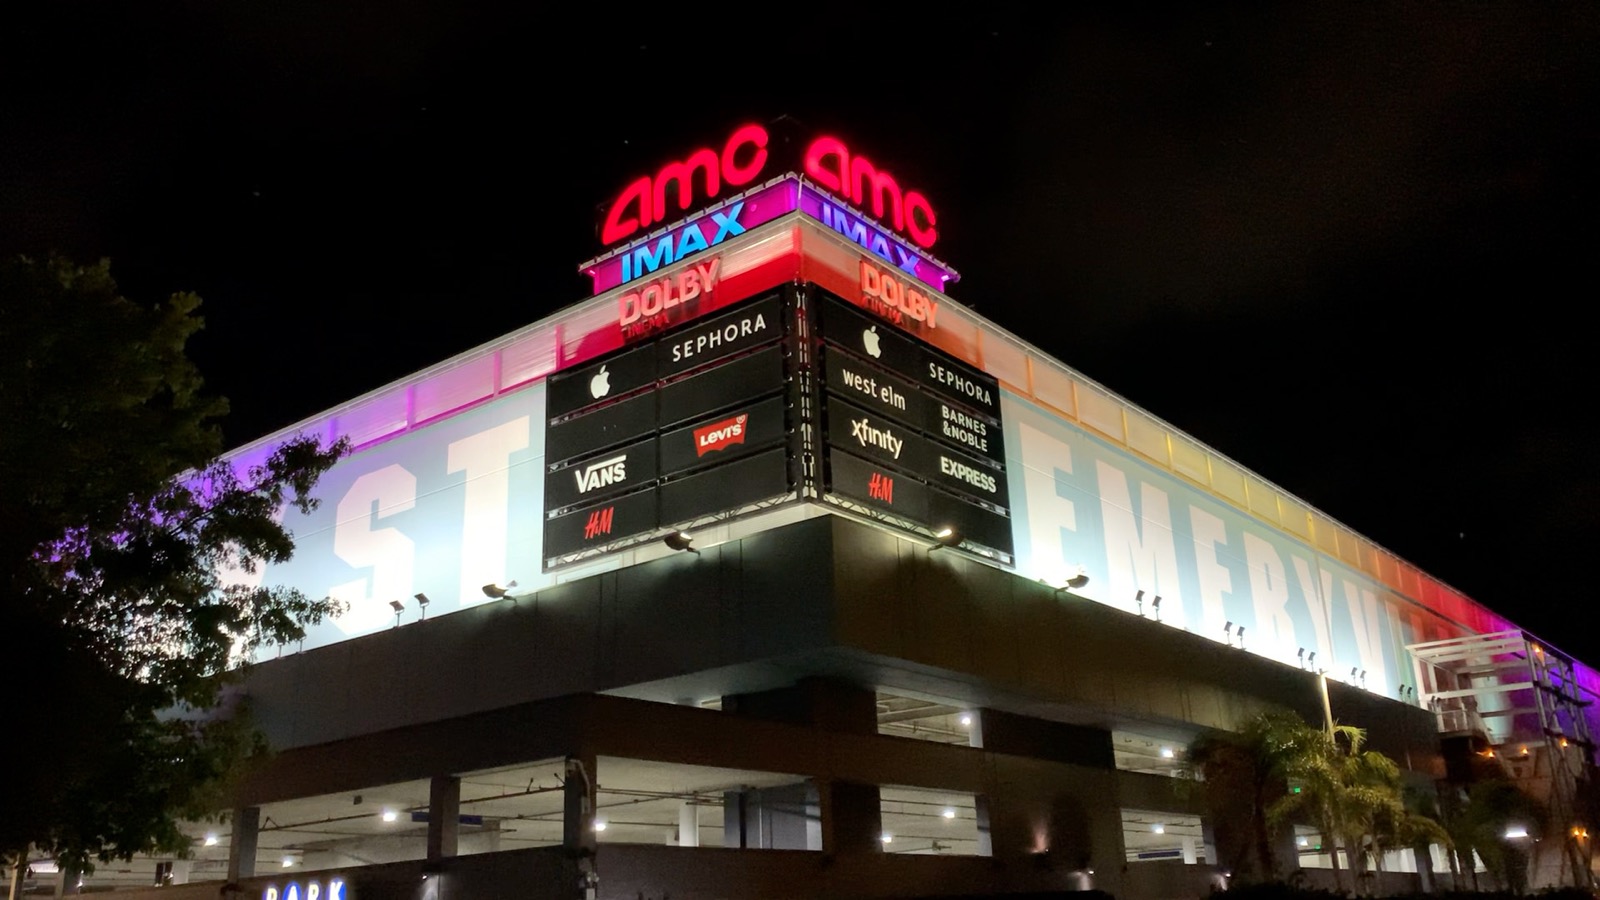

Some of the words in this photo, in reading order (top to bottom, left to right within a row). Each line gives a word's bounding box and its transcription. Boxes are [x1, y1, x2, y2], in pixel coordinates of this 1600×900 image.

[621, 202, 747, 285] IMAX
[819, 201, 921, 278] IMAX
[619, 257, 721, 327] DOLBY
[860, 260, 938, 329] DOLBY
[672, 313, 766, 362] SEPHORA
[843, 368, 878, 398] west
[881, 385, 906, 411] elm
[929, 362, 992, 406] SEPHORA
[851, 418, 903, 460] xfinity
[942, 404, 987, 436] BARNES
[942, 421, 988, 452] &NOBLE
[575, 454, 627, 494] VANS
[940, 456, 997, 493] EXPRESS
